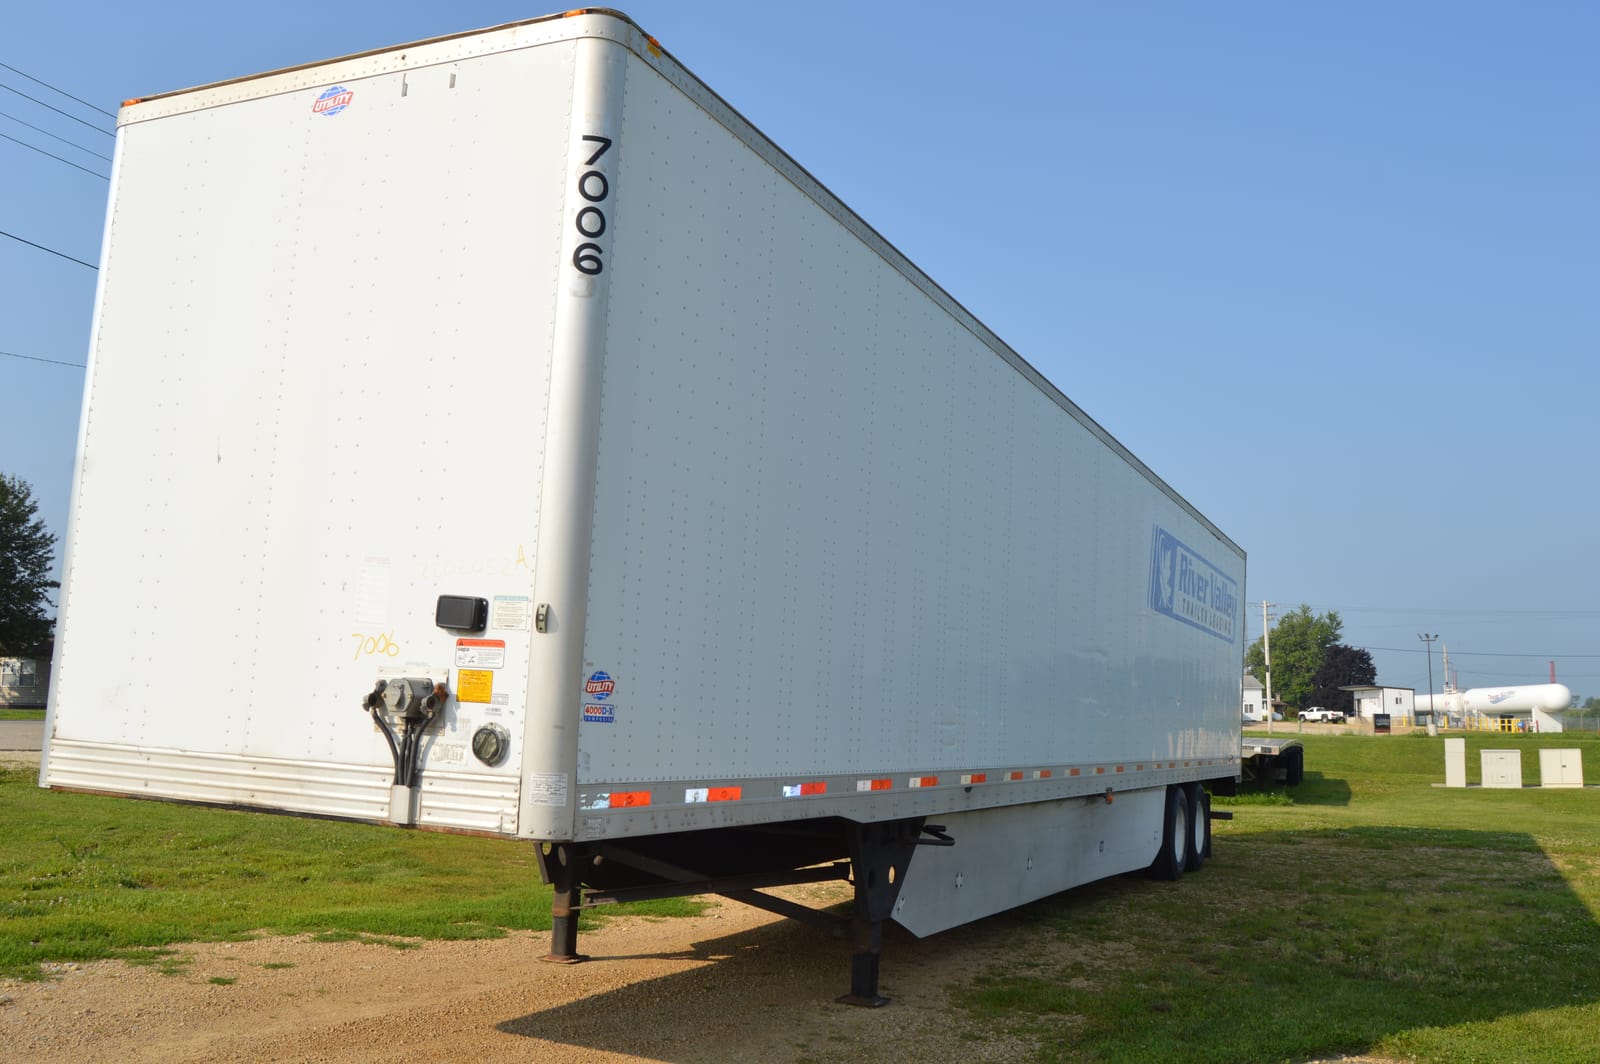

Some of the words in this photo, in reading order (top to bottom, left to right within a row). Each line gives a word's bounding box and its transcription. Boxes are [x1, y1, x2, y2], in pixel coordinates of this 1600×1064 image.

[314, 93, 352, 111] UTILITY
[573, 135, 612, 275] 7006
[1179, 552, 1208, 605] River
[1210, 571, 1238, 620] Valley
[352, 629, 400, 661] 7006
[586, 682, 613, 692] UTILITY
[585, 706, 613, 715] 4000D-X
